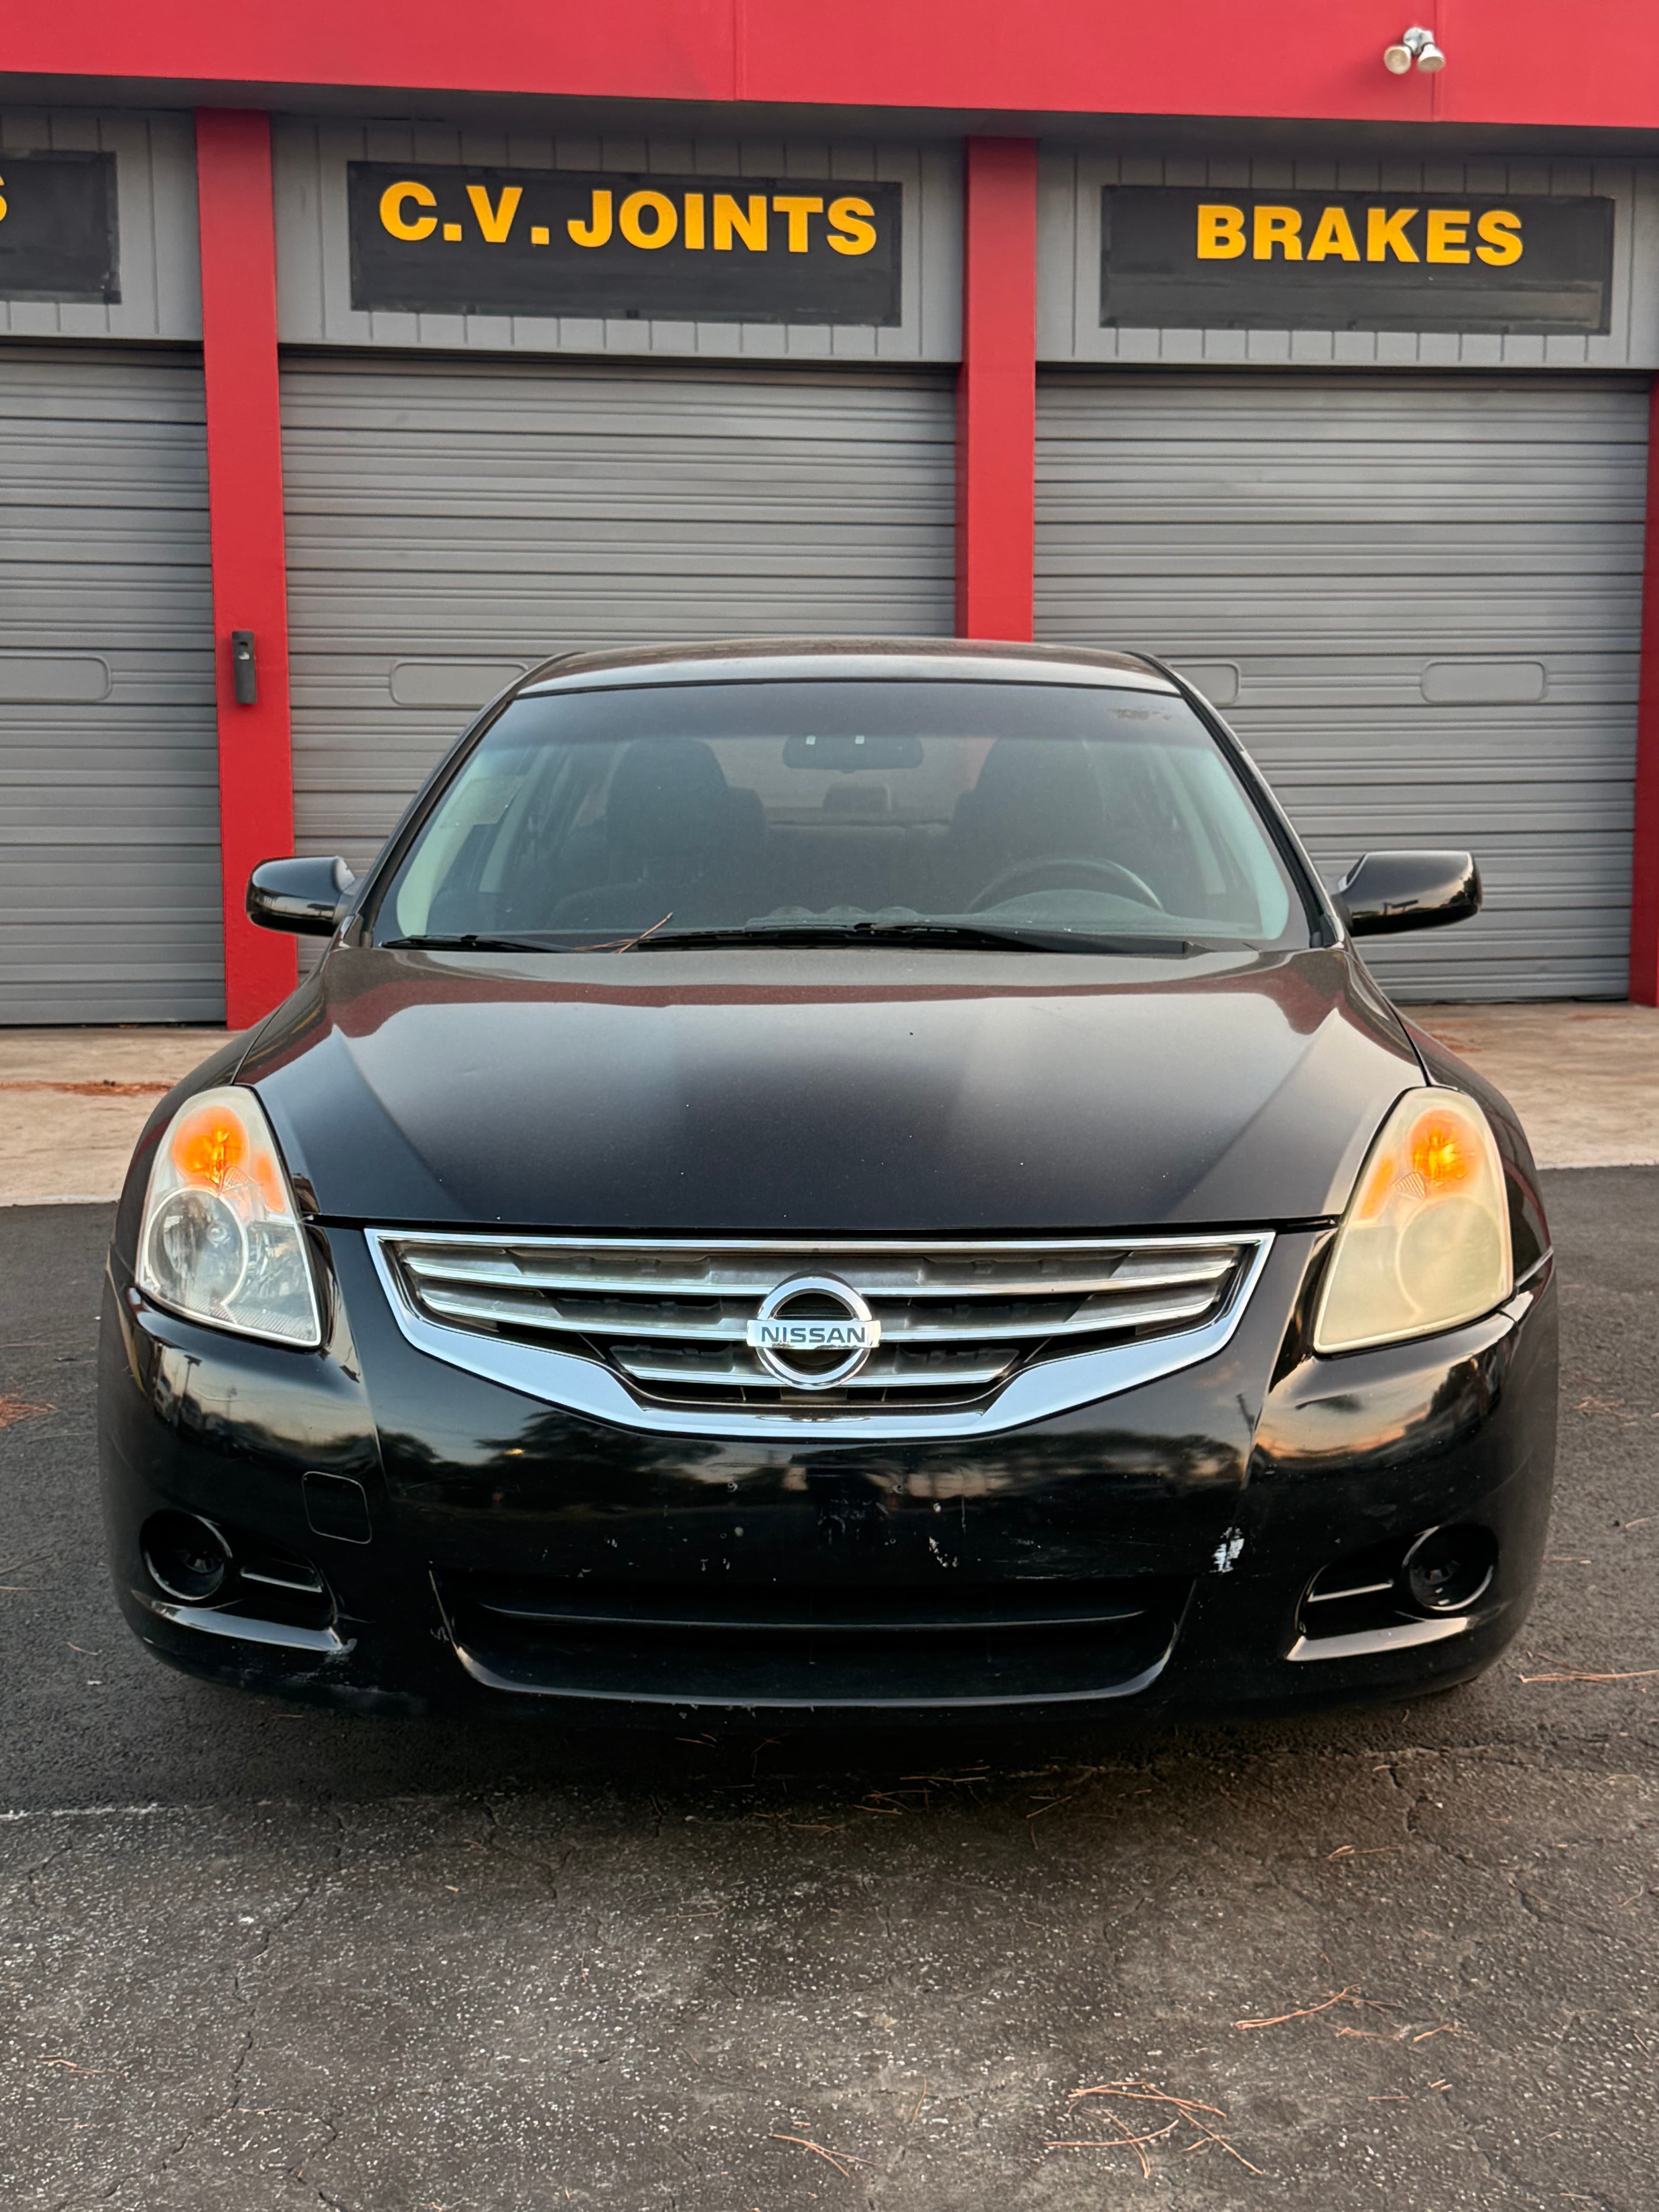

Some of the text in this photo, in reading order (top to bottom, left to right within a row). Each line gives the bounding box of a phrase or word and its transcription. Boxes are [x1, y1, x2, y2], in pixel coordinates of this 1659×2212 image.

[379, 181, 876, 256] C.V. JOINTS
[1196, 204, 1523, 267] BRAKES
[761, 1326, 865, 1343] NISSAN
